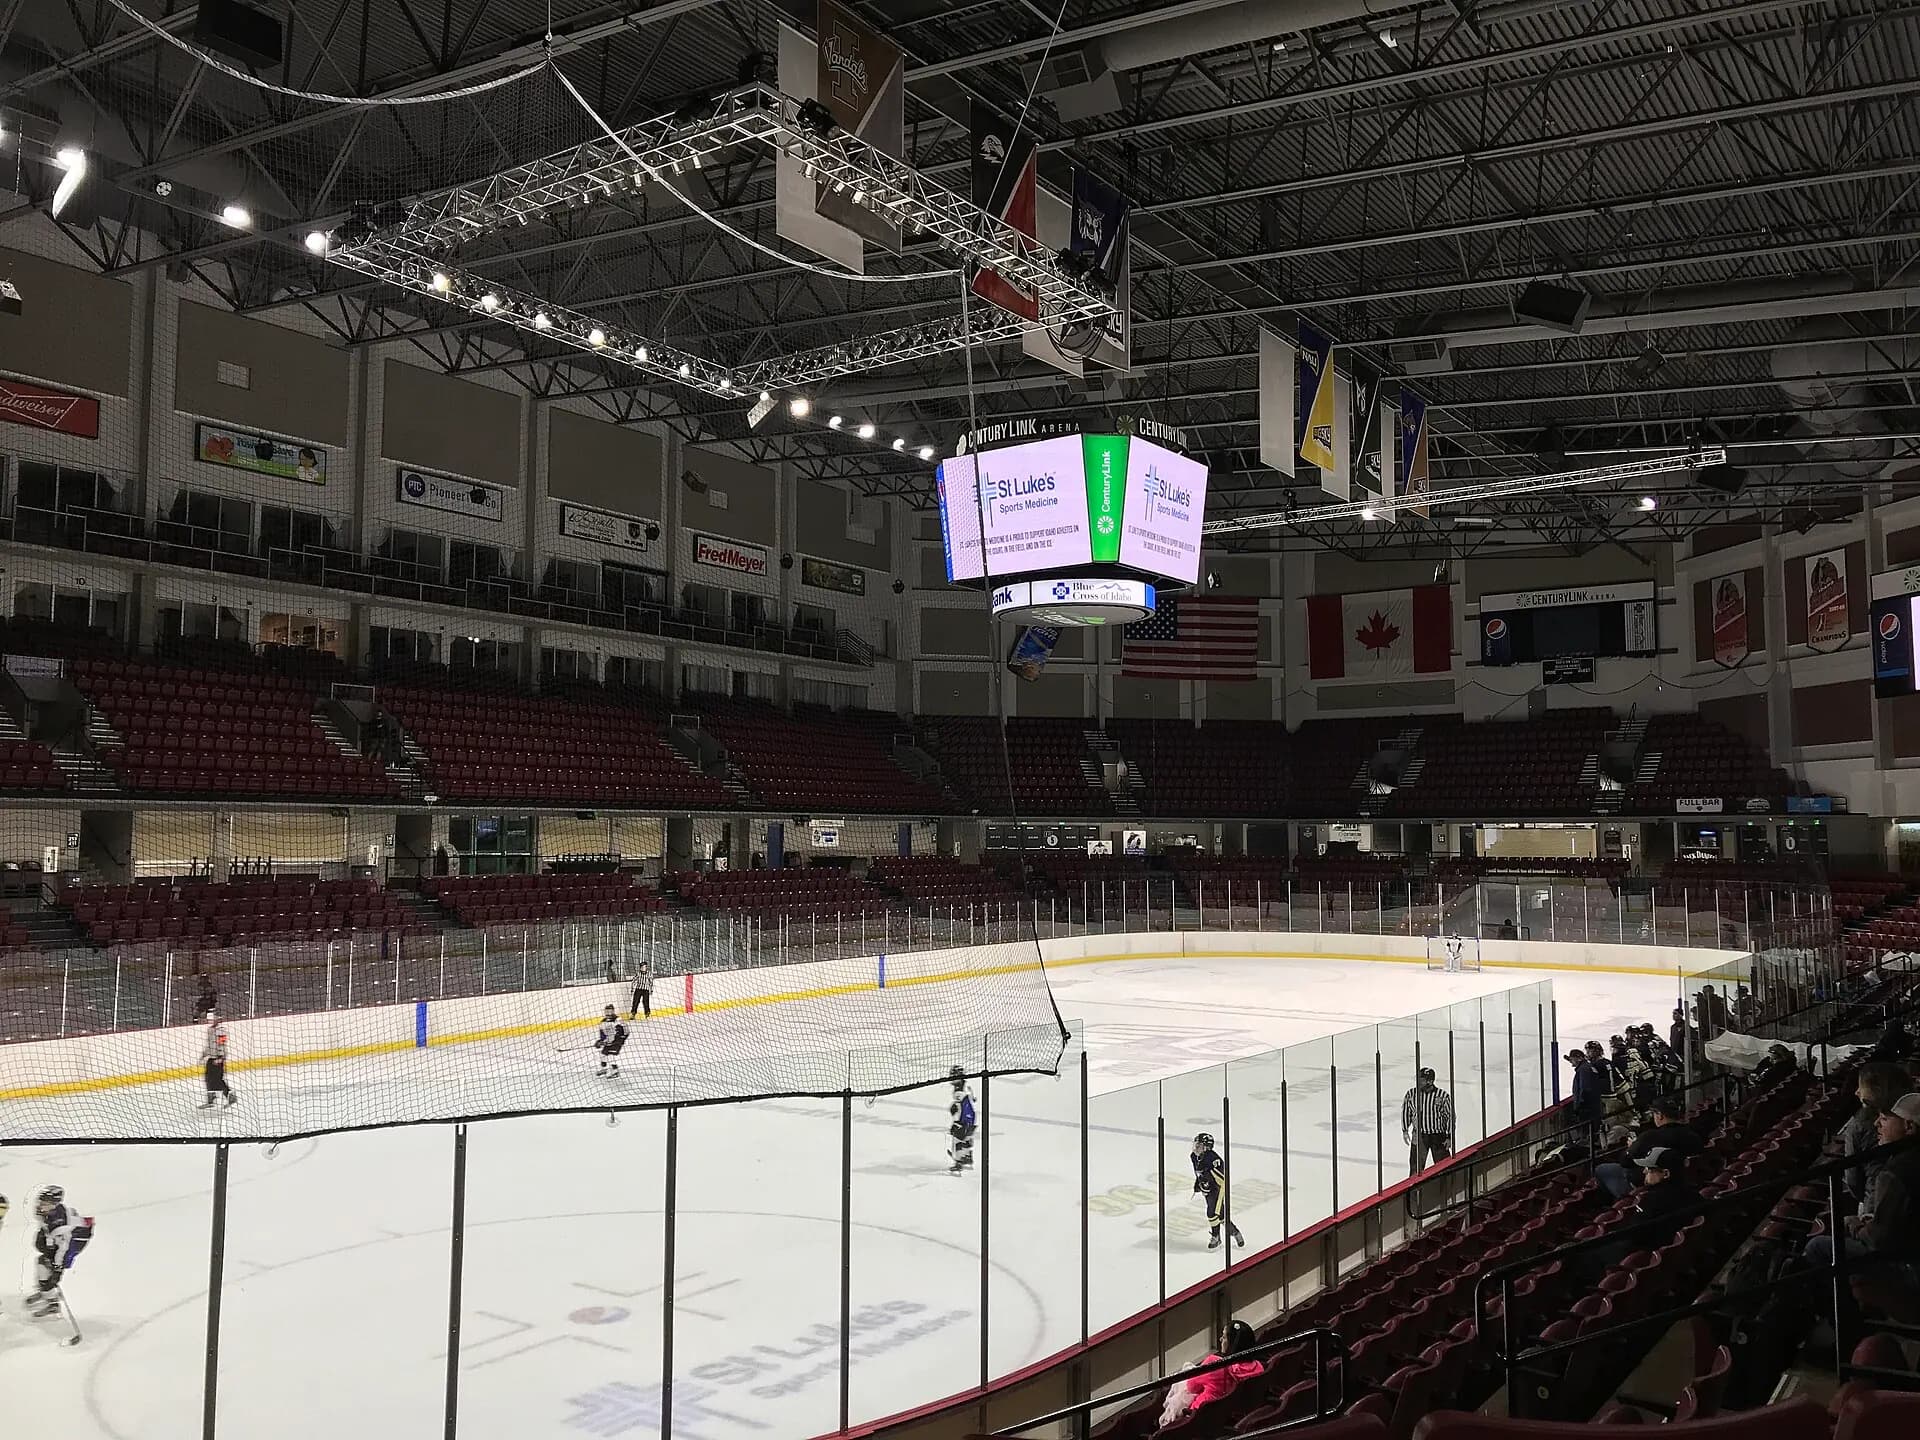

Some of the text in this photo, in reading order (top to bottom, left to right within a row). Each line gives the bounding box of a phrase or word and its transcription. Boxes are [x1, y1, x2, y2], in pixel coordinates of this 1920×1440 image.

[1041, 423, 1080, 433] ARENA
[998, 473, 1055, 497] St Luke's
[1101, 450, 1112, 512] CenturyLink
[430, 484, 466, 502] Pioneer
[1159, 479, 1191, 507] St Luke's
[1000, 497, 1058, 514] Sports Medicine
[1072, 582, 1094, 590] Blue
[993, 587, 1013, 608] ank
[1072, 592, 1131, 601] Cross of Idaho
[1532, 591, 1588, 605] CENTURYLINK
[1680, 798, 1720, 806] FULL BAR
